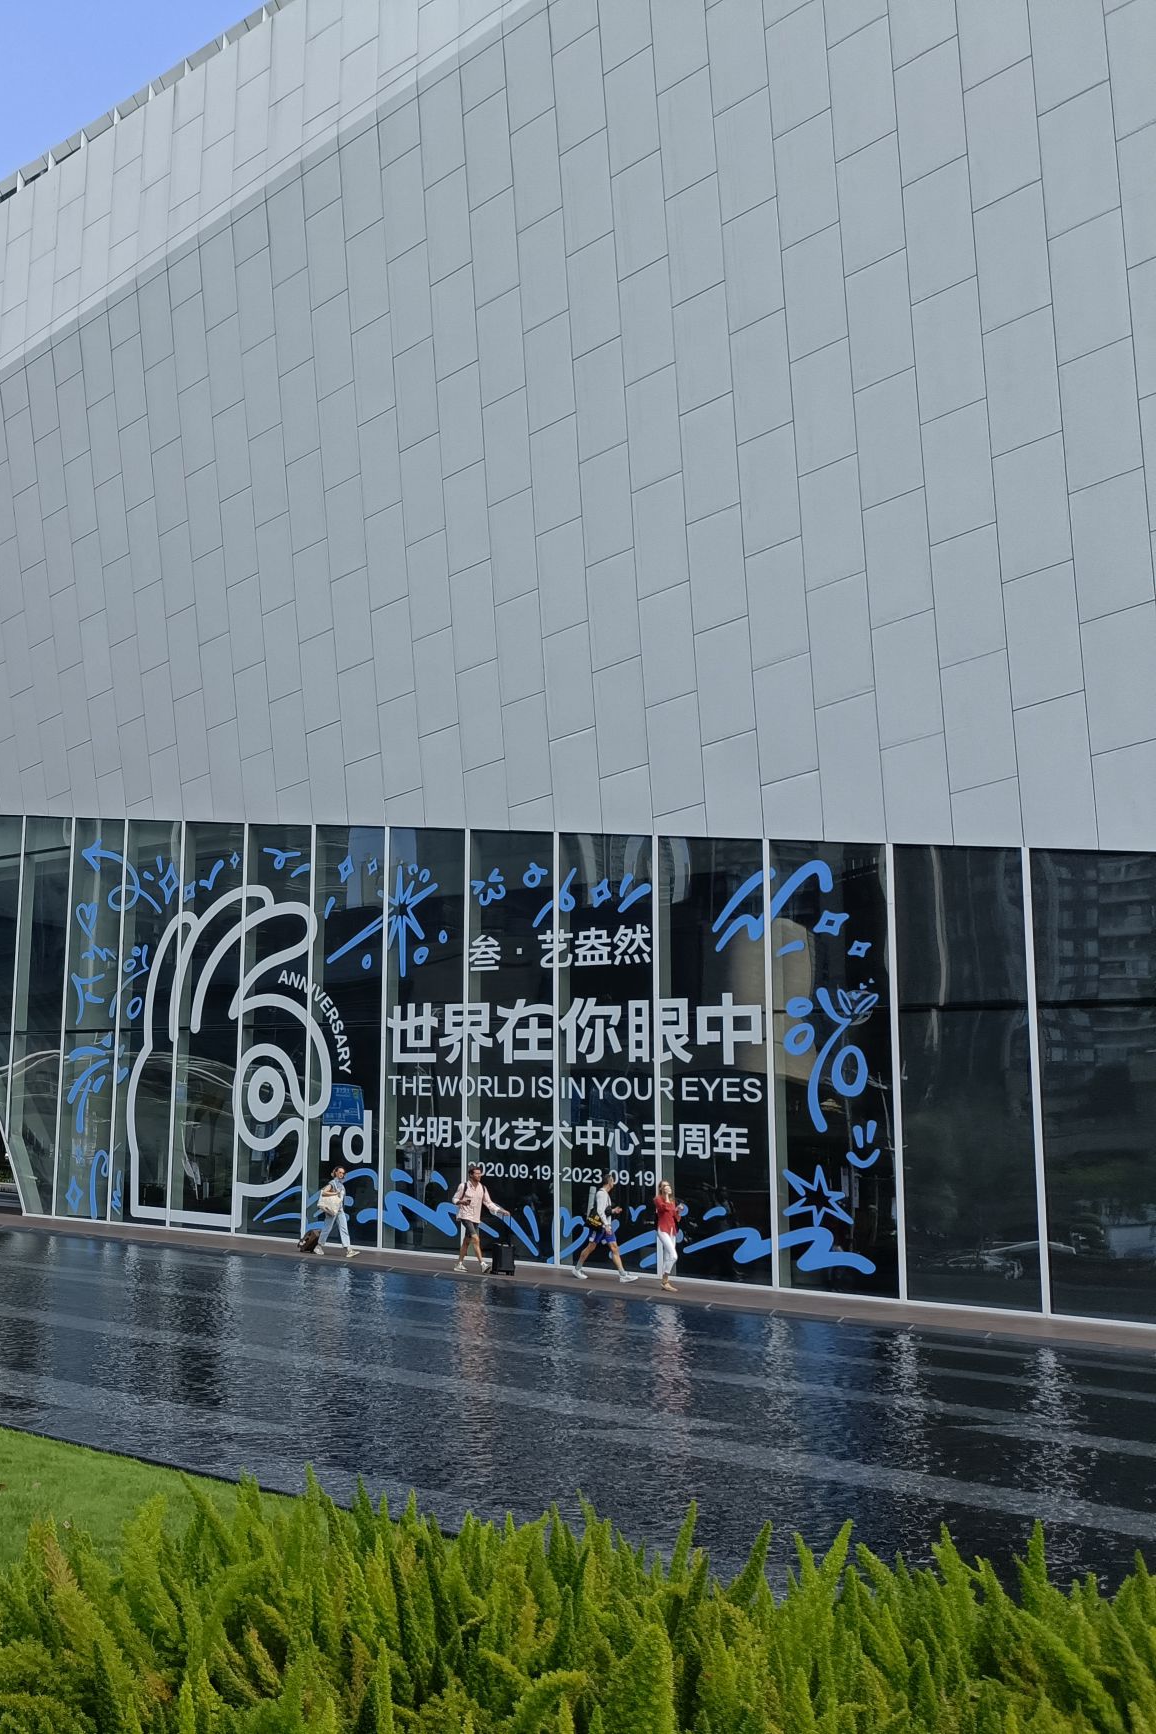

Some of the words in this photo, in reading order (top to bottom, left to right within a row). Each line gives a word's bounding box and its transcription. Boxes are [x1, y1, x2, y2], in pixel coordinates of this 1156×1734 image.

[277, 969, 352, 1075] ANNIVERSARY
[387, 993, 763, 1065] 世界在你眼中
[387, 1075, 432, 1096] THE
[437, 1076, 525, 1098] WORLD
[531, 1076, 553, 1099] IS
[560, 1077, 586, 1099] IN
[592, 1077, 675, 1100] YOUR
[681, 1077, 763, 1103] EYES
[398, 1114, 750, 1162] 光明文化艺术中心三周年
[467, 1161, 655, 1187] 020.09.19-202309.19
